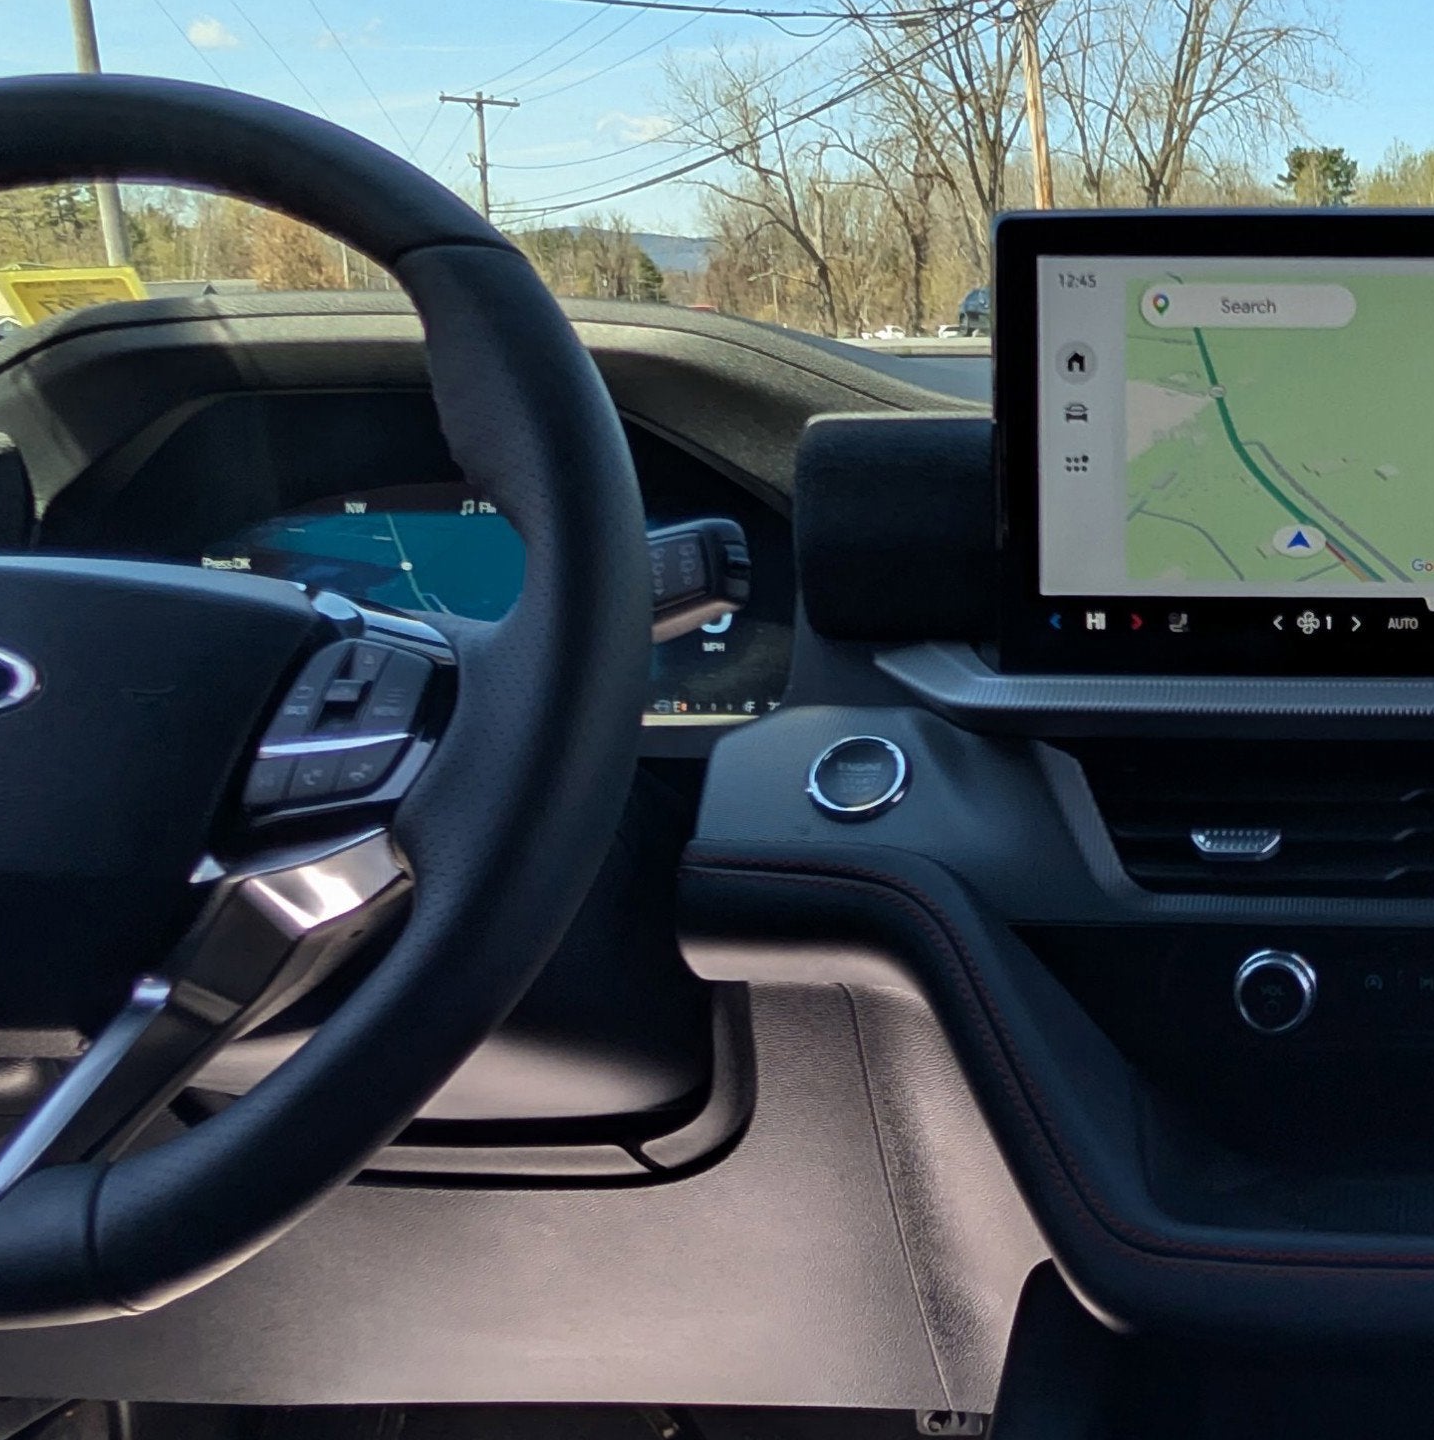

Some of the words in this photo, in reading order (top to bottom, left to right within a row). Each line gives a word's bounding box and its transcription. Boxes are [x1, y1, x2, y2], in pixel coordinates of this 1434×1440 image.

[1058, 273, 1098, 288] 12:45
[1220, 298, 1277, 316] Search
[345, 501, 367, 514] NW
[201, 556, 233, 570] Press
[1085, 612, 1107, 631] HI
[1325, 616, 1333, 631] 1
[1387, 616, 1419, 631] AUTO
